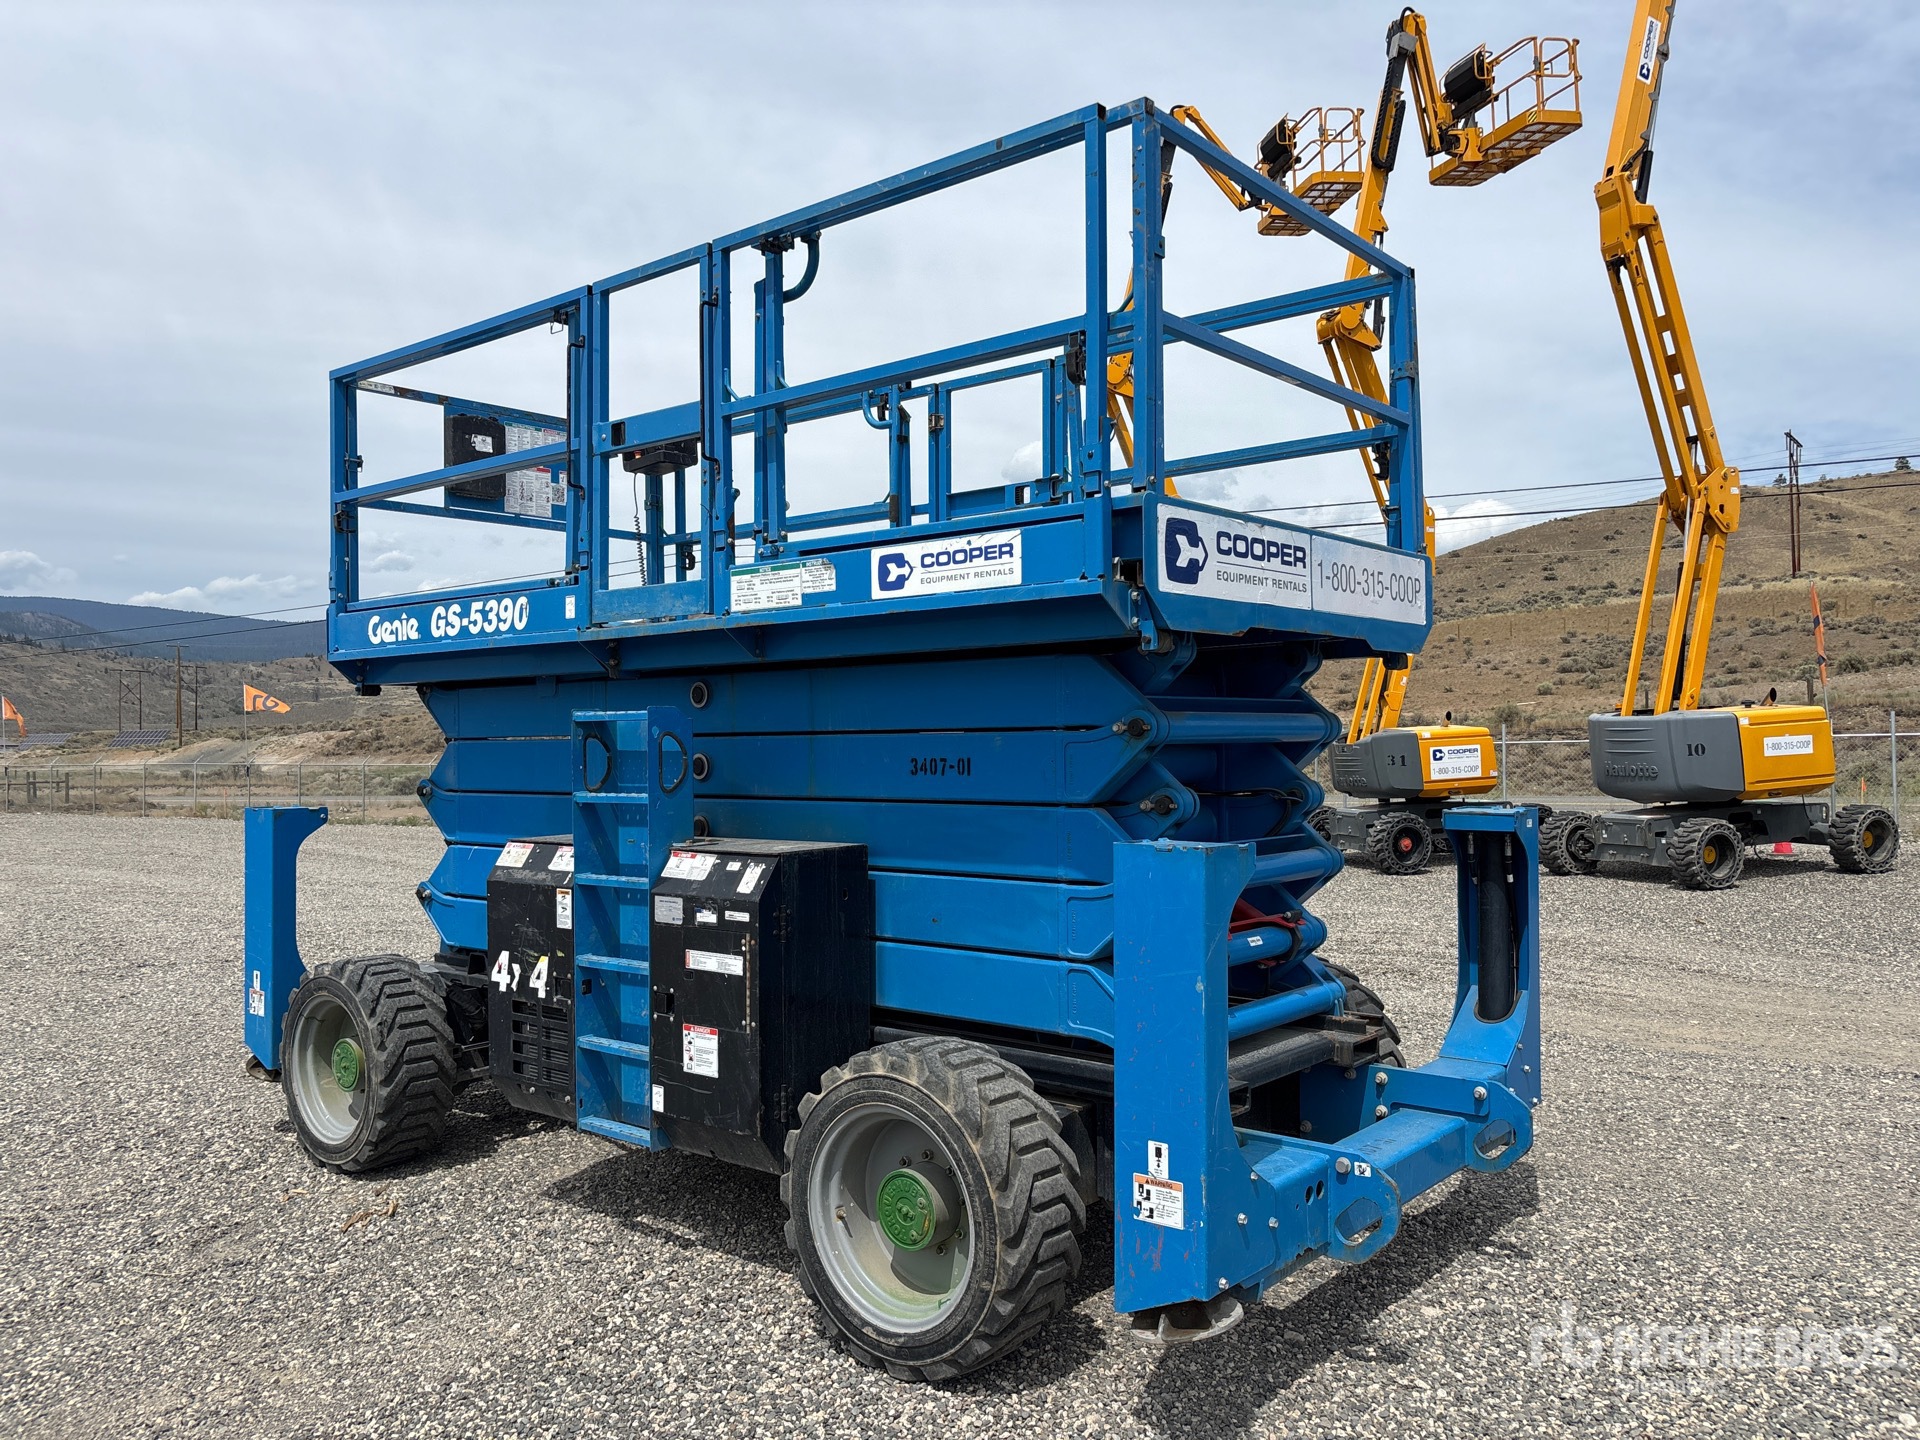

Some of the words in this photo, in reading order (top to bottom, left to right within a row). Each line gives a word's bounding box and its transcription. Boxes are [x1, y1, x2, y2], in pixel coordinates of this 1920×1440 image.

[920, 542, 1014, 569] COOPER
[1216, 531, 1307, 569] COOPER
[920, 573, 971, 585] EQUIPMENT
[973, 567, 1015, 579] RENTALS
[1216, 570, 1269, 588] EQUIPMENT
[1272, 578, 1307, 593] RENTALS
[1317, 559, 1421, 604] 1-800-315-COOP
[368, 612, 419, 645] Genie
[430, 596, 529, 638] GS-5390
[1447, 747, 1479, 755] COOPER
[1686, 743, 1706, 756] 10
[1387, 754, 1407, 767] 31
[1150, 1180, 1173, 1189] WARNING
